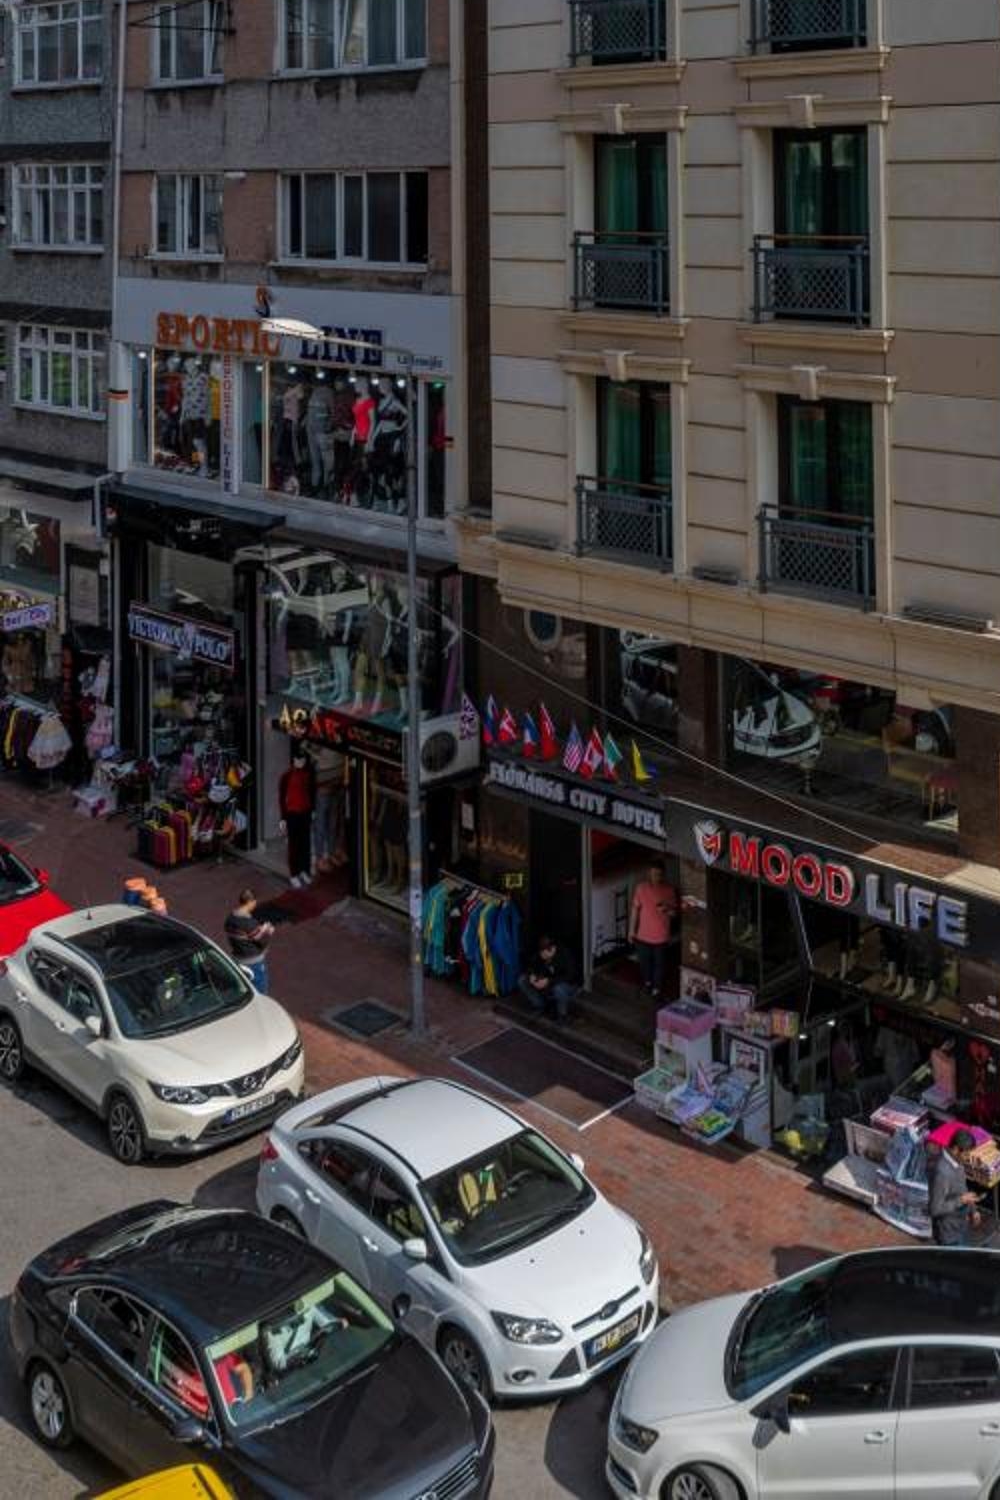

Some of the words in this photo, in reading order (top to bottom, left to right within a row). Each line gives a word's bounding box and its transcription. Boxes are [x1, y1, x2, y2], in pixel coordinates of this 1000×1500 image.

[301, 325, 384, 367] LINE
[569, 787, 607, 816] CITY
[610, 799, 663, 834] HOTEL
[728, 831, 855, 907] MOOD
[865, 872, 969, 948] LIFE
